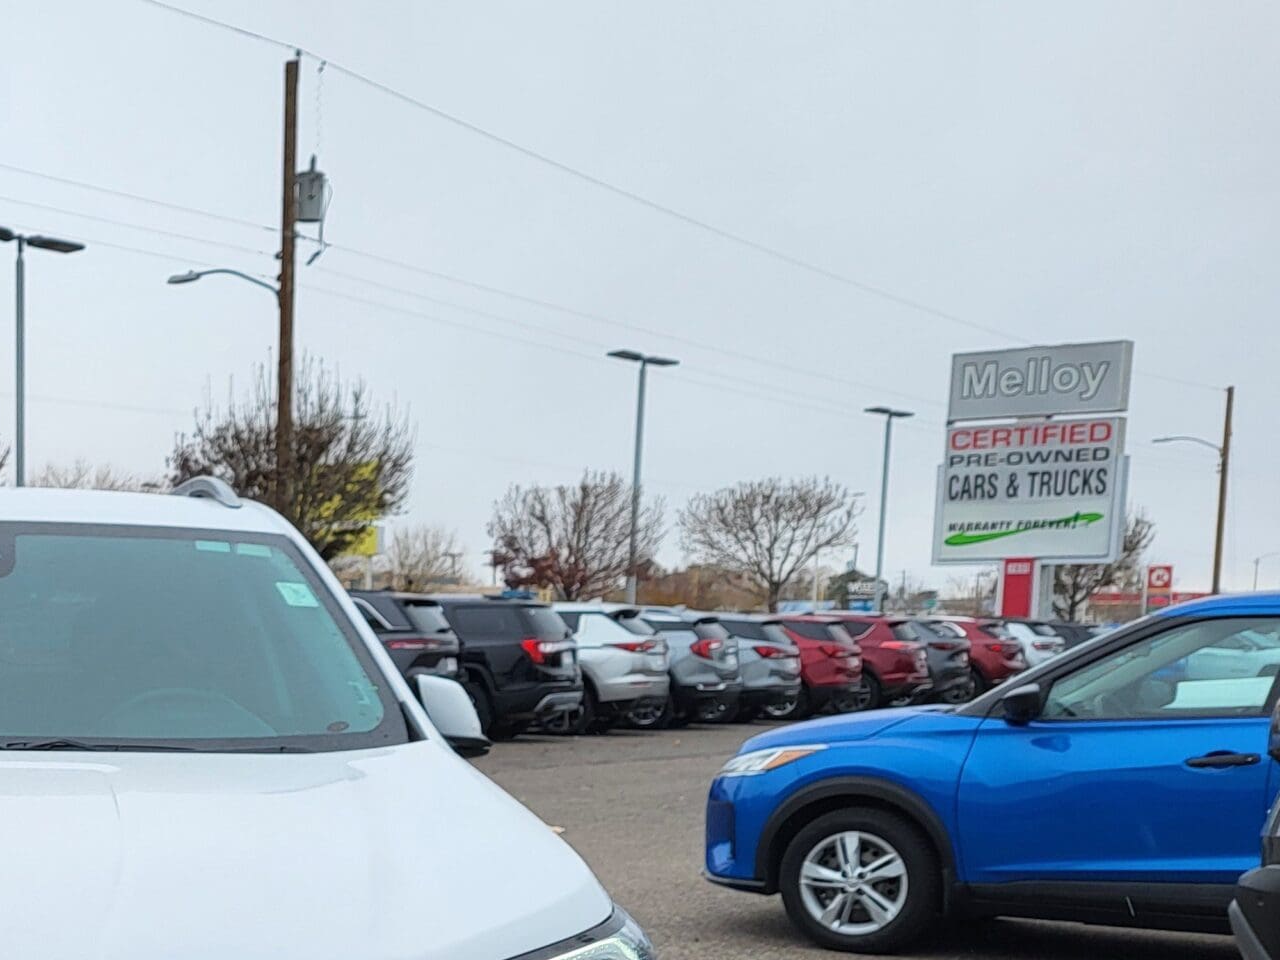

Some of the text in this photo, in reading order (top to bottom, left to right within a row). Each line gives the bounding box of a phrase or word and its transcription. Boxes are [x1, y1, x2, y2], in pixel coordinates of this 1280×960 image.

[961, 355, 1111, 401] Melloy
[950, 420, 1114, 452] CERTIFIED
[949, 446, 1111, 468] PRE-OWNED
[948, 467, 1108, 501] CARS & TRUCKS
[948, 520, 1012, 533] WARRANTY
